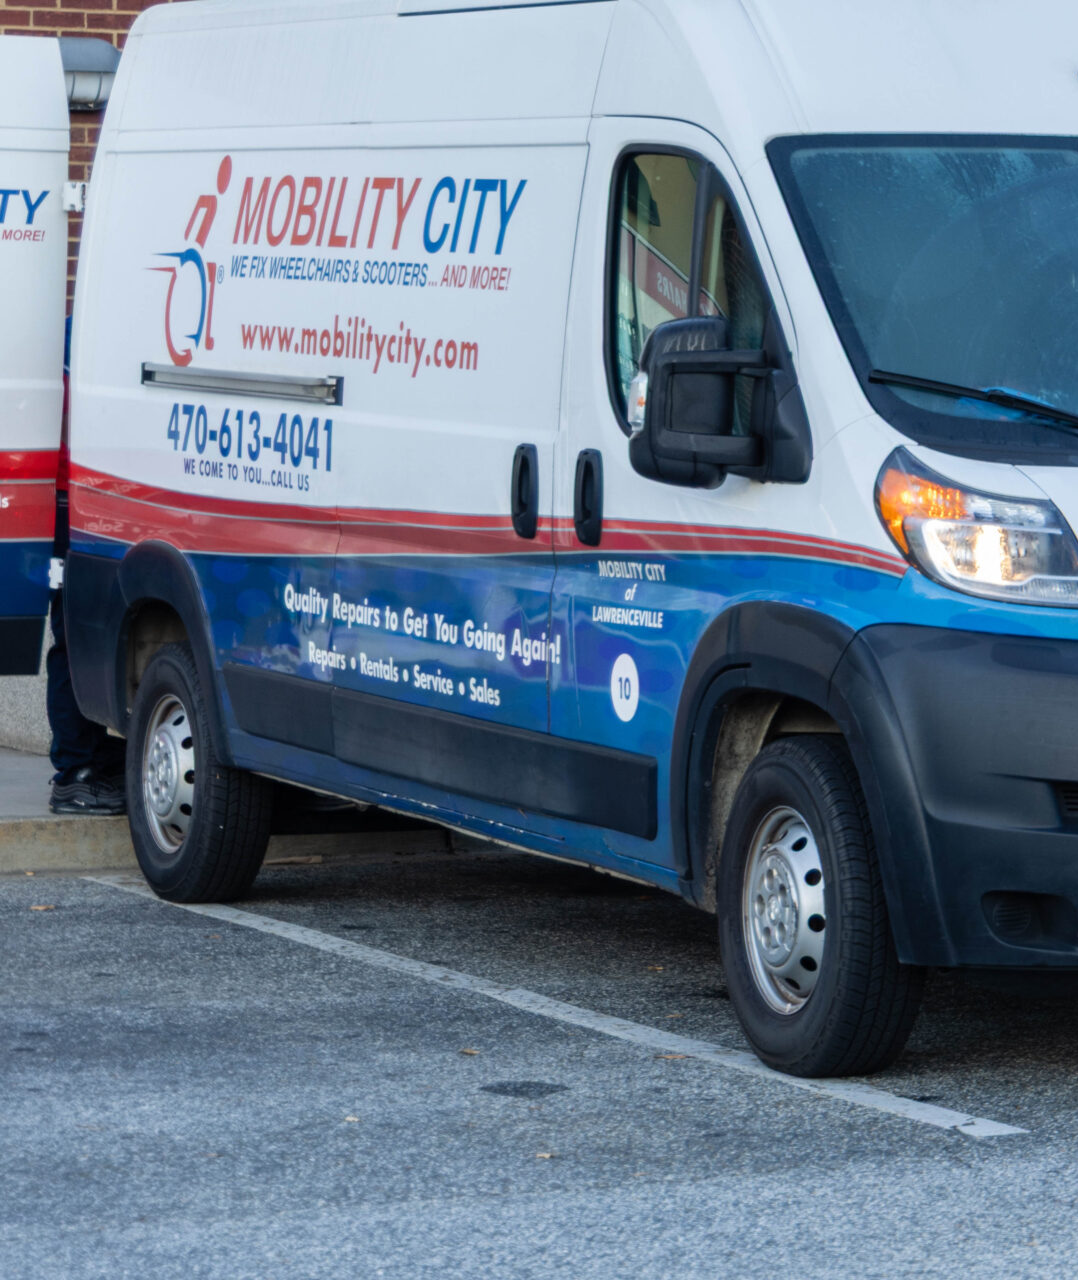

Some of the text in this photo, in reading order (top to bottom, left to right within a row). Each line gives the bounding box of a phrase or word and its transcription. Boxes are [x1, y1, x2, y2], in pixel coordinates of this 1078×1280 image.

[232, 175, 528, 255] MOBILITY CITY
[2, 229, 46, 242] MORE!
[230, 255, 249, 278] WE
[249, 256, 268, 279] FIX
[268, 256, 352, 284] WHEELCHAIRS
[352, 260, 360, 284] &
[440, 264, 466, 289] AND
[469, 265, 512, 291] MORE!
[240, 315, 479, 378] www.mobilitycity.com
[167, 402, 333, 472] 470-613-4041
[183, 458, 196, 475] WE
[199, 459, 224, 479] COME
[227, 463, 238, 481] TO
[297, 474, 310, 492] US
[598, 560, 667, 582] MOBILITY CITY
[624, 583, 638, 601] of
[283, 583, 561, 667] Quality Repairs to Get You Going Again!
[592, 605, 664, 629] LAWRENCEVILLE
[308, 641, 501, 706] Repairs Rentals Service Sales
[618, 676, 632, 700] 10
